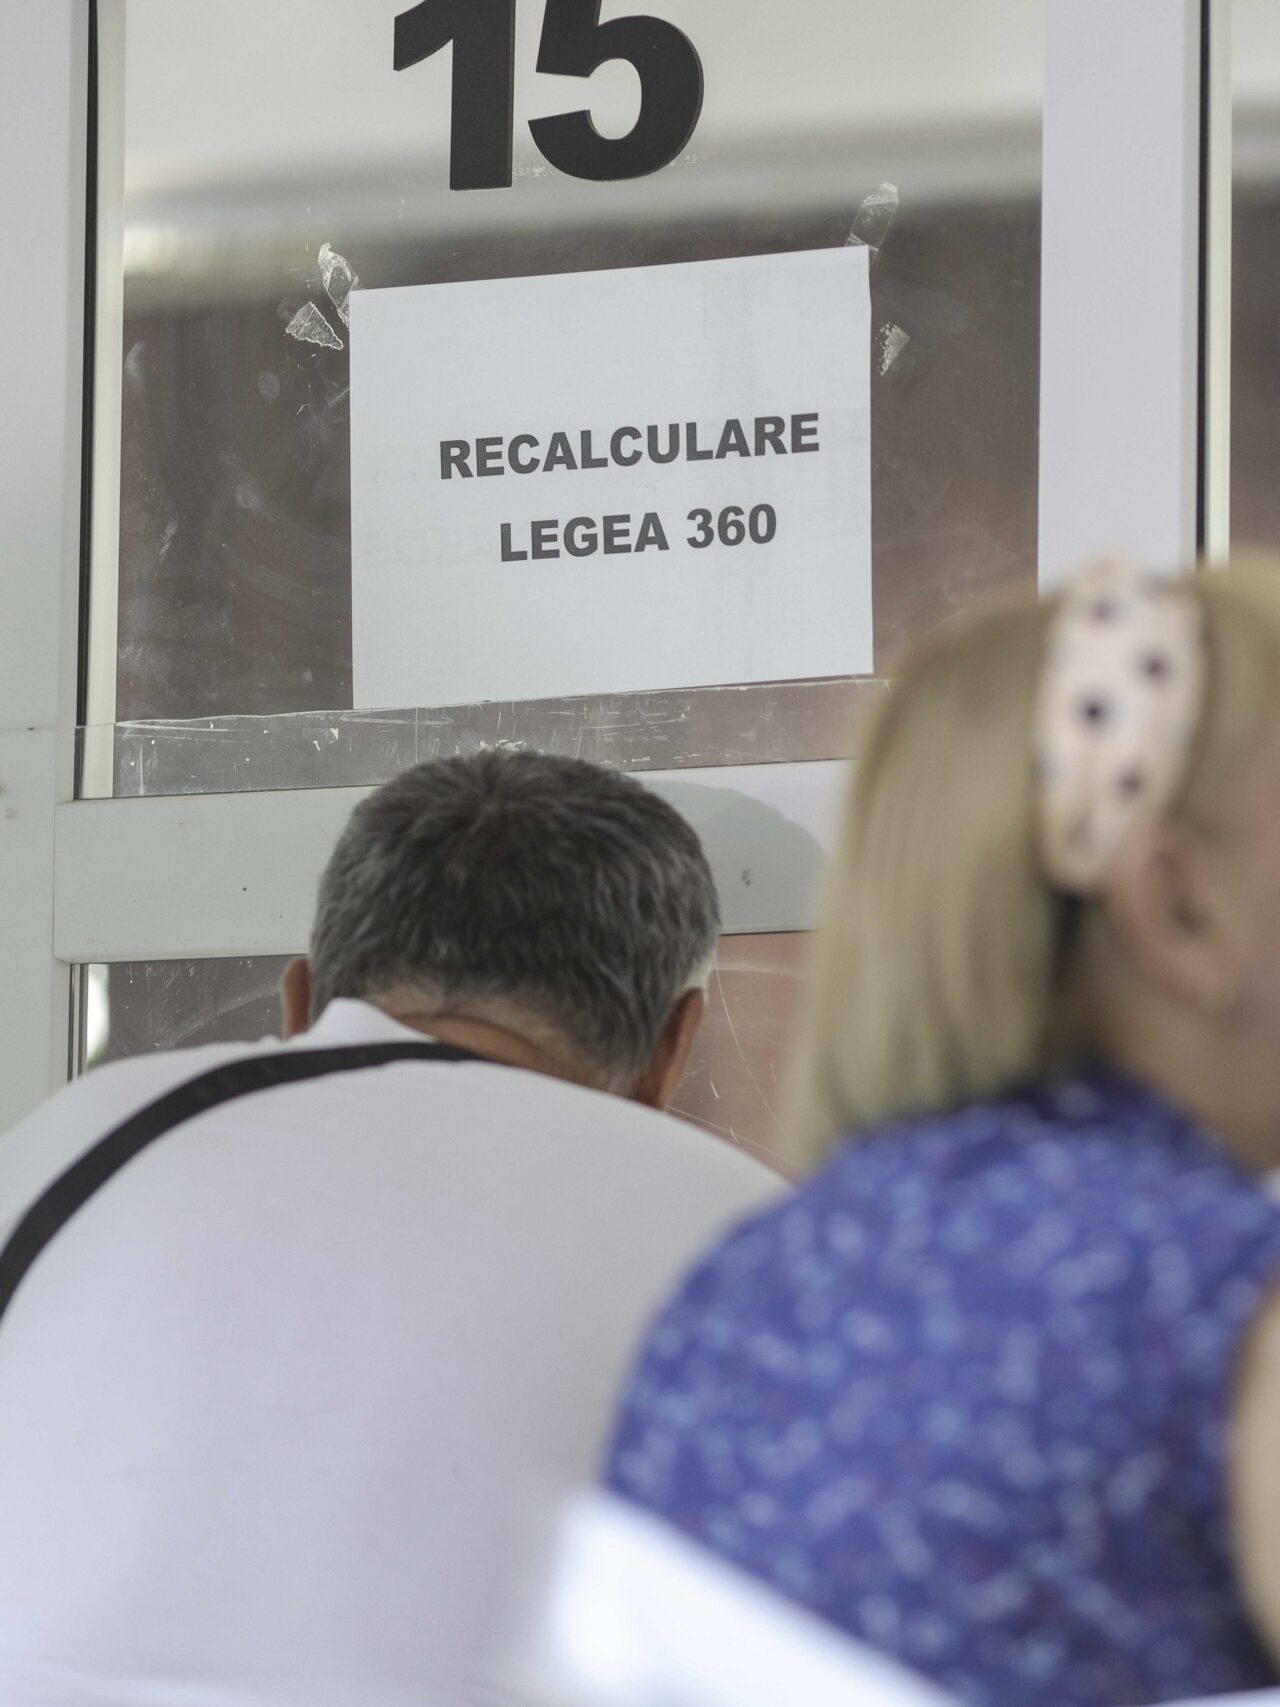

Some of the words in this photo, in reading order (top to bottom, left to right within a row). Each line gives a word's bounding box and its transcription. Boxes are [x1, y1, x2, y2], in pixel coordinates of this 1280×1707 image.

[393, 0, 704, 191] 15
[439, 412, 820, 480] RECALCULARE
[500, 512, 670, 562] LEGEA
[686, 503, 777, 549] 360
